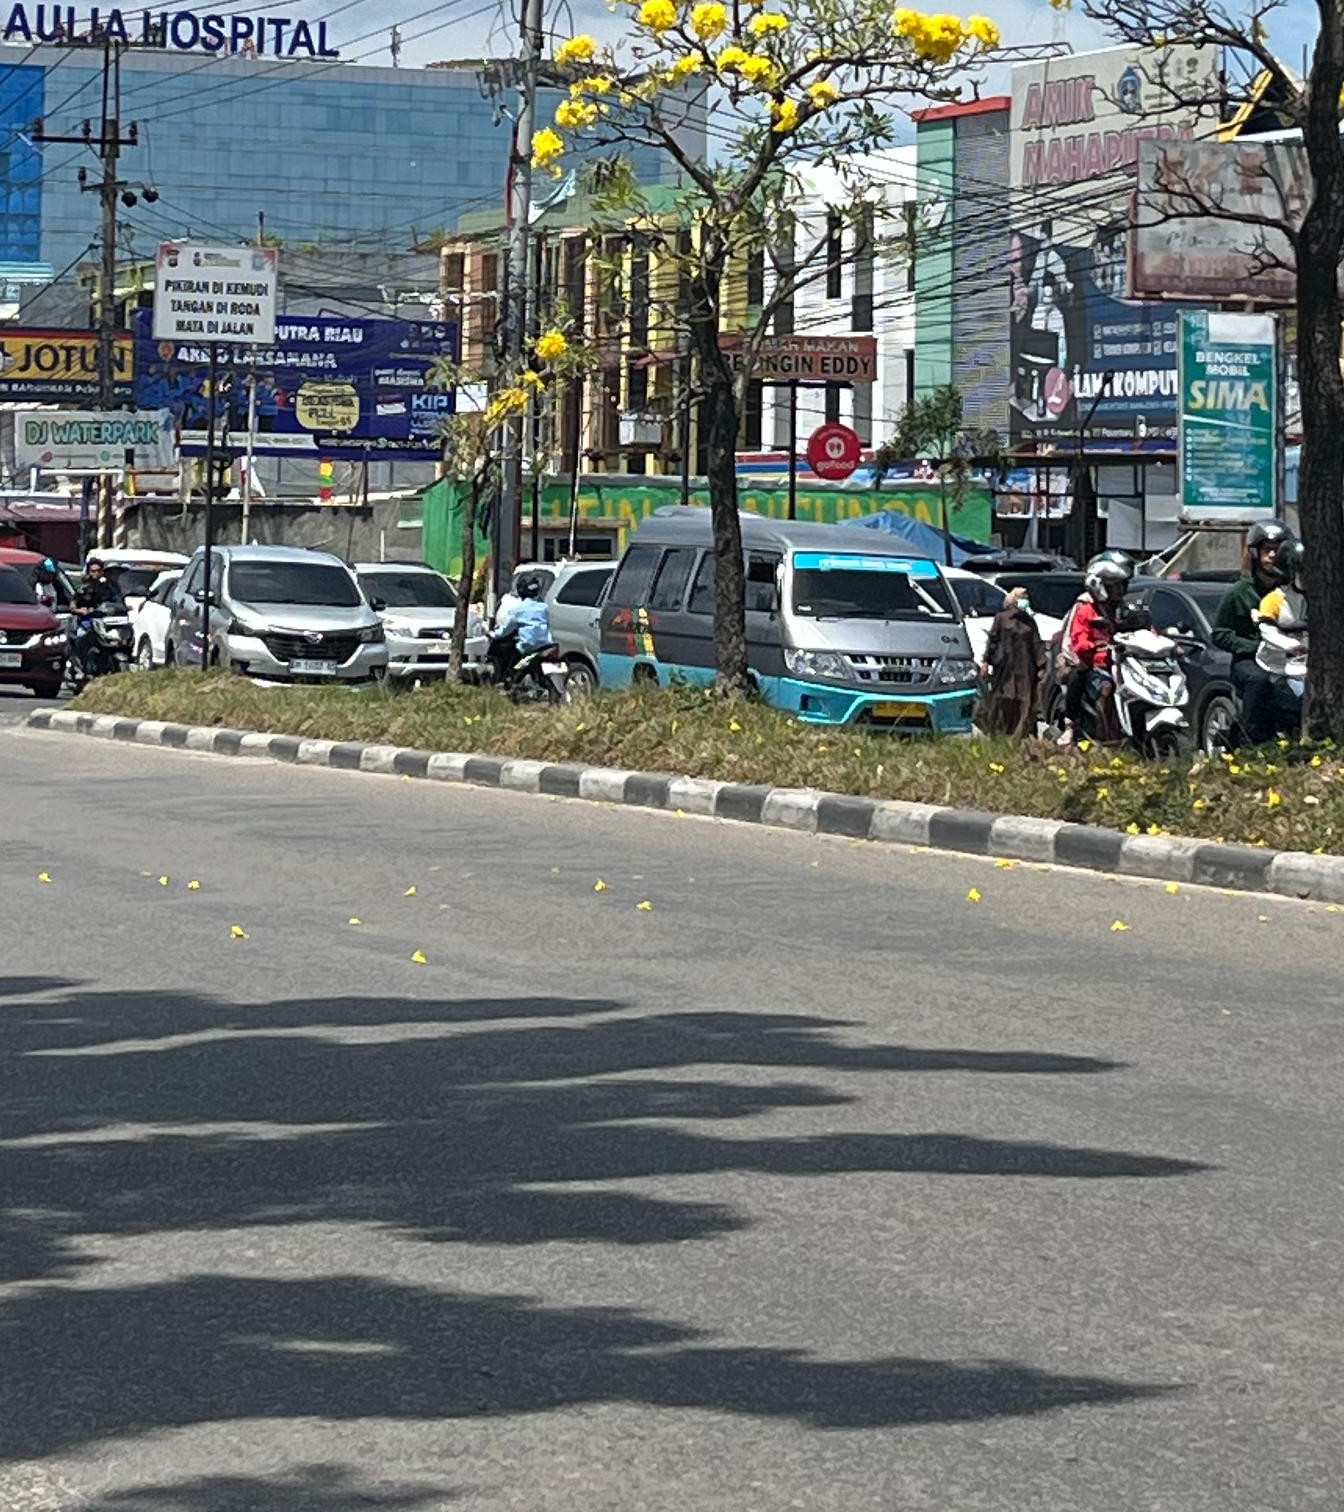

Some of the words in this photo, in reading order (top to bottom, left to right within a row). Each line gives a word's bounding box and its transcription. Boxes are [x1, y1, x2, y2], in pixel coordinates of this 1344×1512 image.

[3, 2, 129, 42] AULIA
[143, 9, 340, 58] HOSPITAL
[212, 281, 223, 295] DI
[216, 301, 228, 315] DI
[221, 322, 255, 336] JALAN
[821, 356, 871, 375] EDDY
[412, 394, 448, 410] KIP
[1188, 378, 1270, 412] SIMA
[24, 420, 49, 445] DJ
[51, 420, 160, 445] WATERPARK
